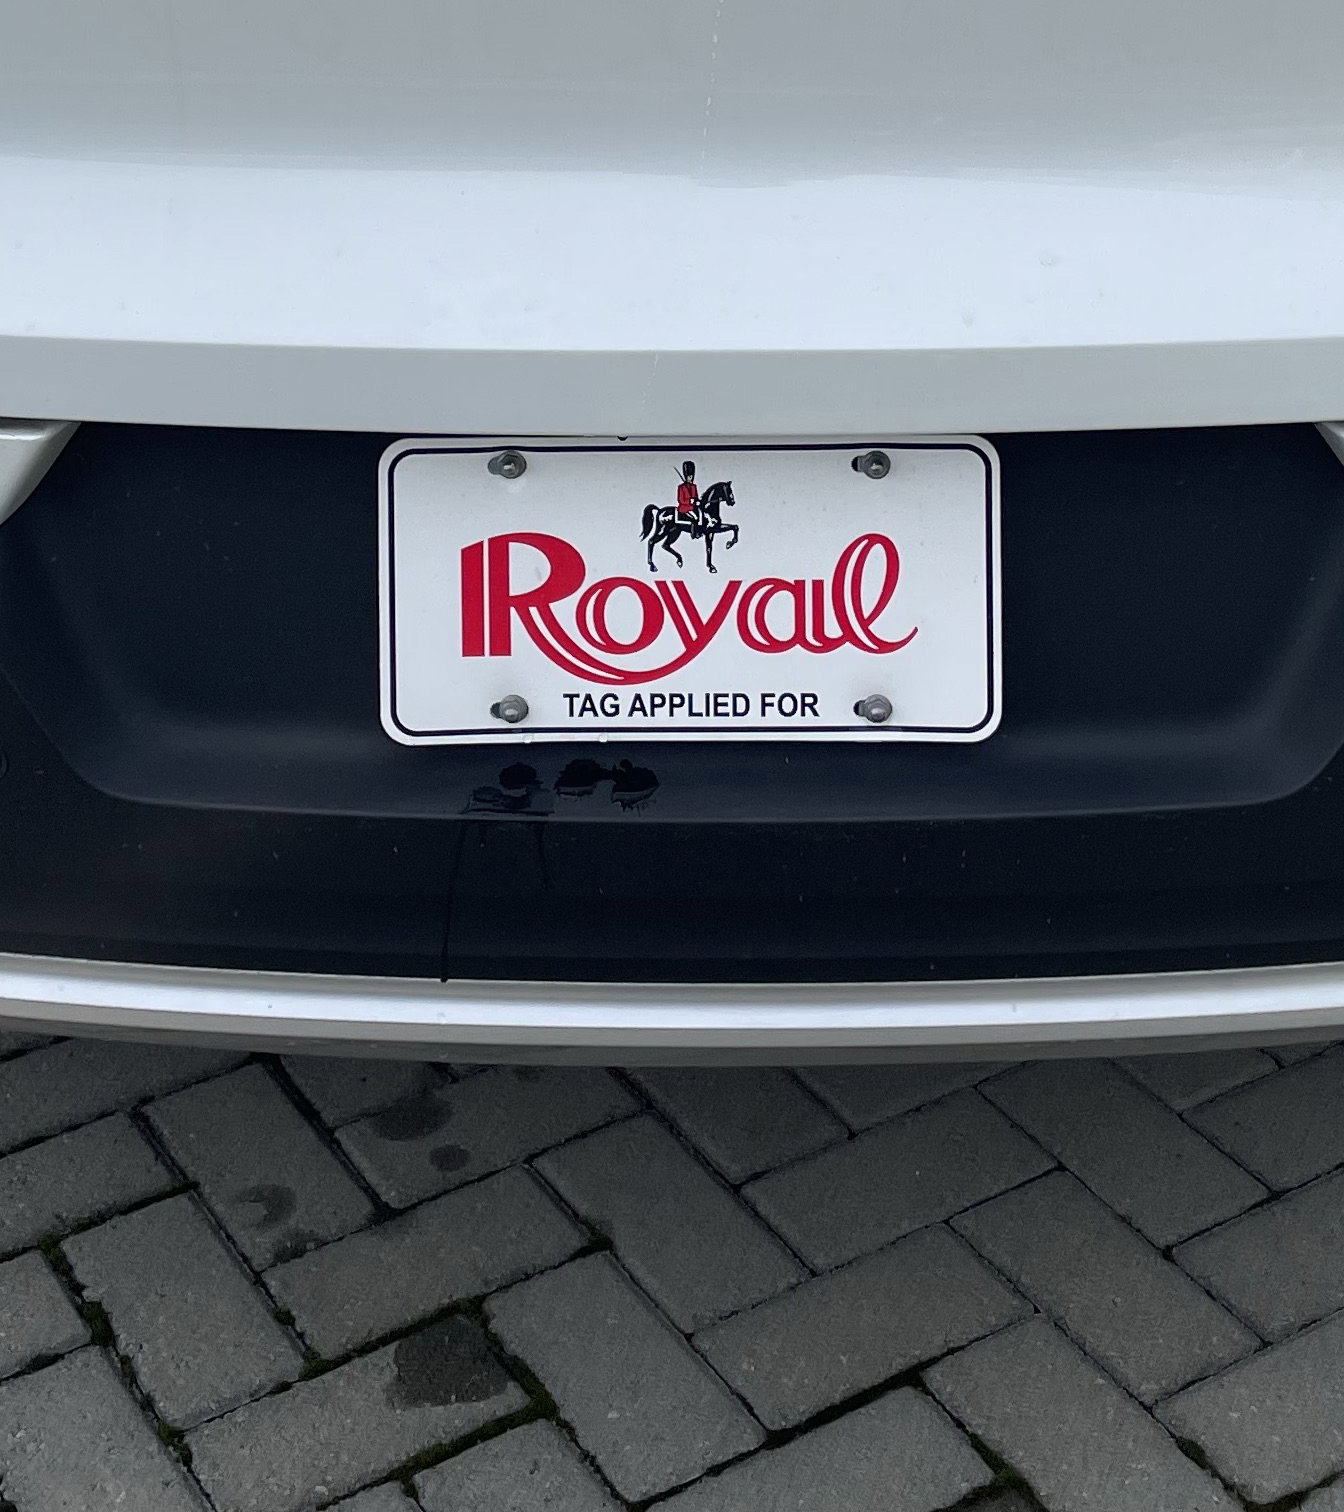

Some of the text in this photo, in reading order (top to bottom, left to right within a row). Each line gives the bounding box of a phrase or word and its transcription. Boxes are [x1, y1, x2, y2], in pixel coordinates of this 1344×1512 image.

[460, 532, 919, 685] Royal
[563, 692, 821, 718] TAG APPLIED FOR
